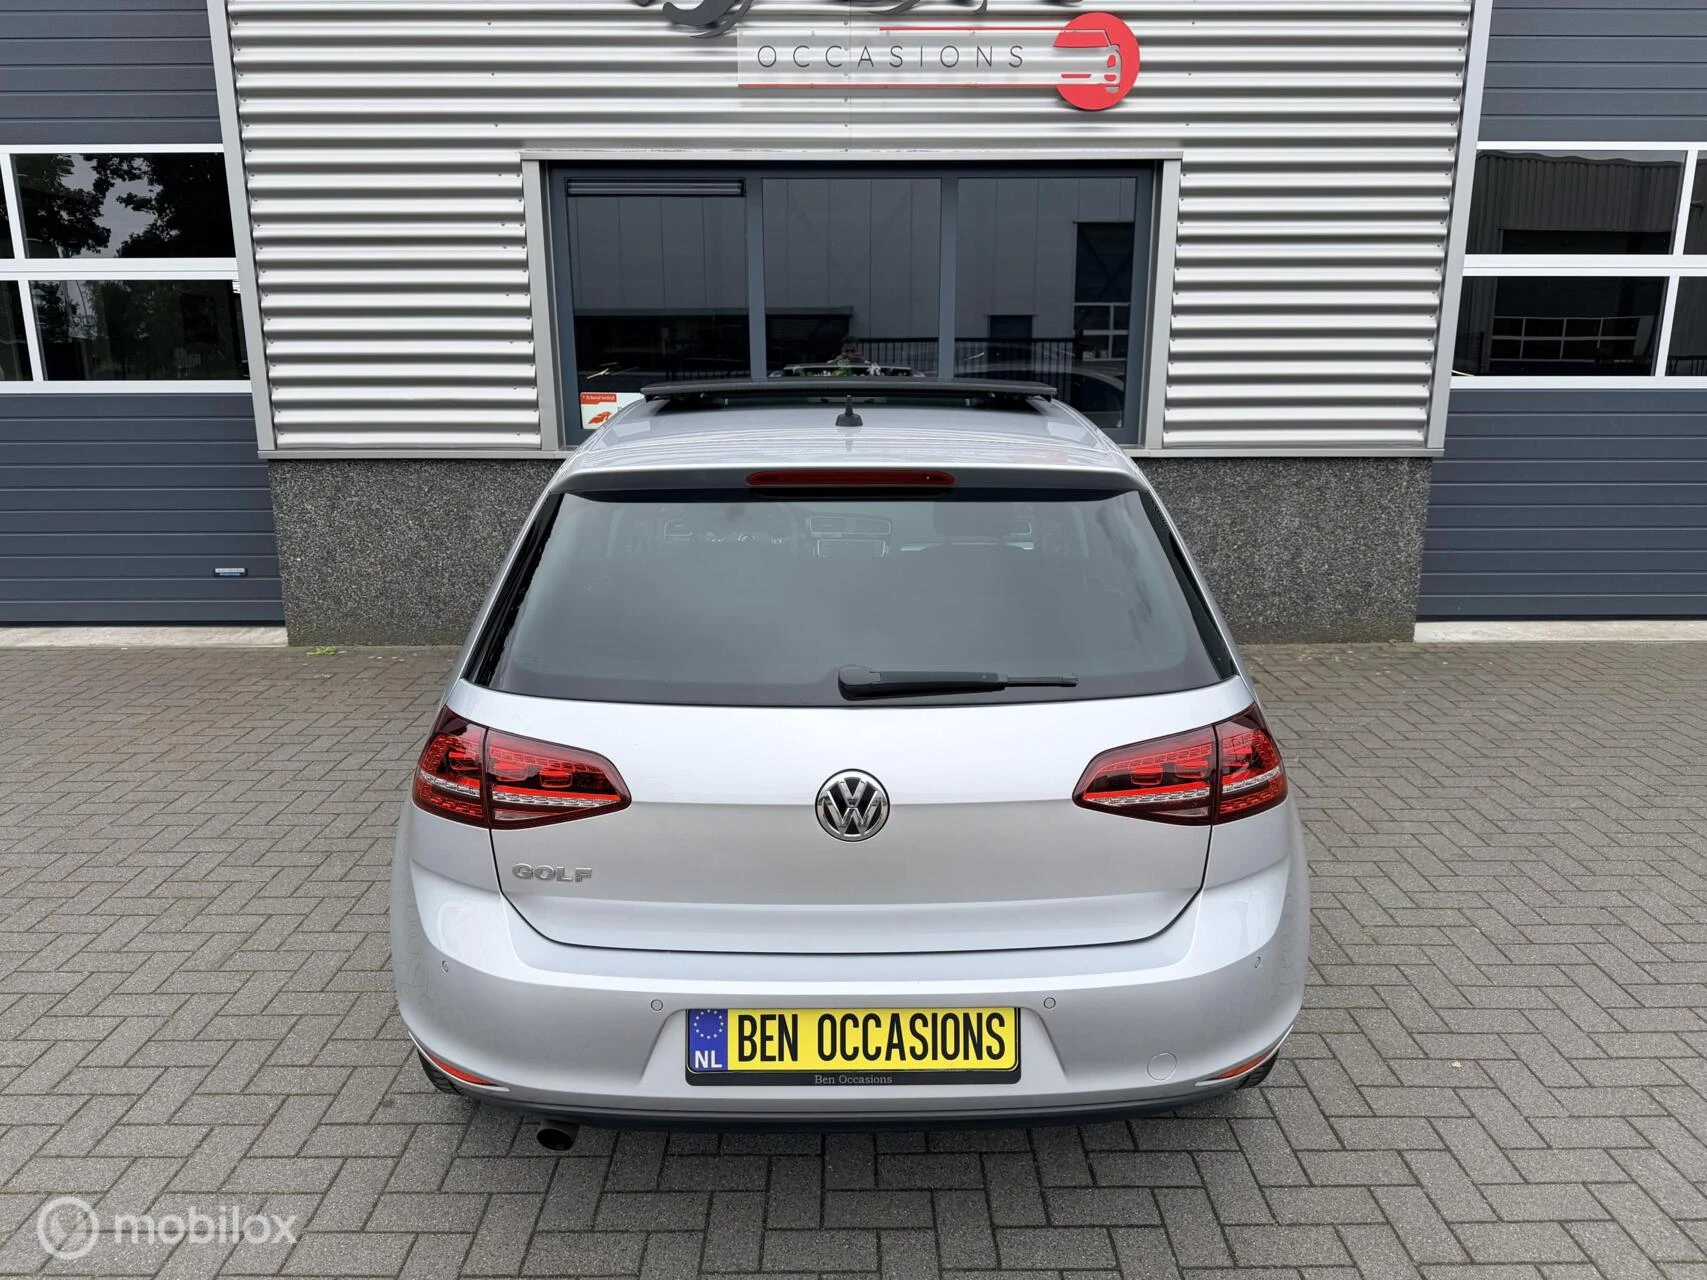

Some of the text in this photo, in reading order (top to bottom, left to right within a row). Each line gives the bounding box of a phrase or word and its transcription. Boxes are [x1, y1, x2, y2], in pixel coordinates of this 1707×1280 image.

[756, 44, 1025, 69] OCCASIONS
[817, 771, 888, 840] VW
[512, 863, 592, 882] GOLF
[737, 1011, 1006, 1062] BEN OCCASIONS
[694, 1050, 723, 1069] NL
[814, 1074, 893, 1085] Ben Occasions
